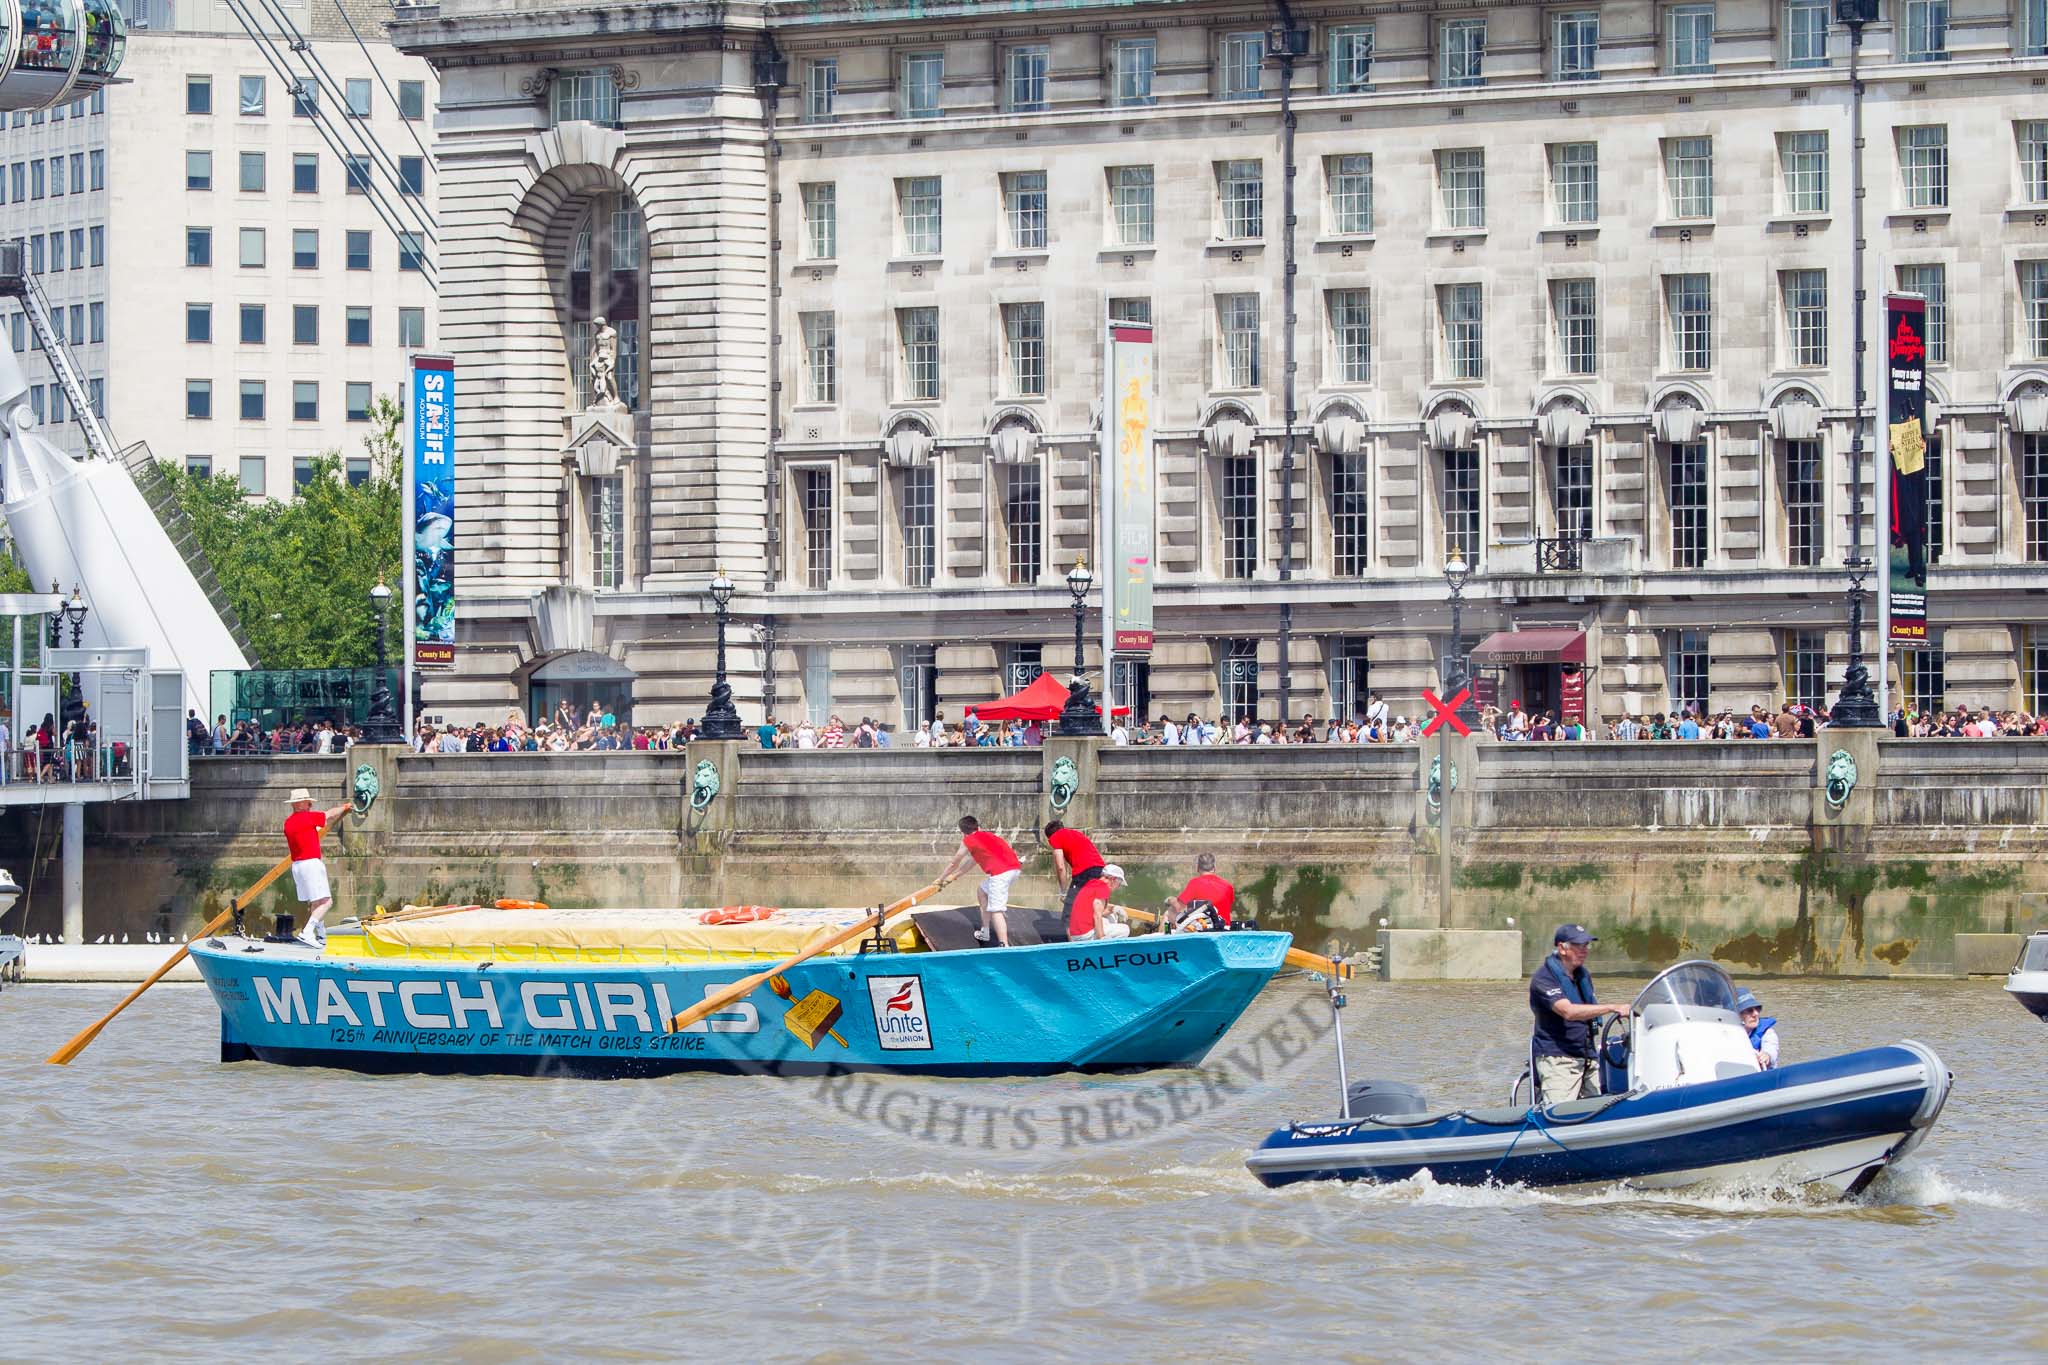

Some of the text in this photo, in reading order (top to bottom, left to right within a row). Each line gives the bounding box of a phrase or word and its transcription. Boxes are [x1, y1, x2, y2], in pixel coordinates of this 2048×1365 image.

[1892, 626, 1924, 636] County Hall
[1119, 634, 1149, 645] County Hall
[418, 650, 451, 660] County Hall
[1488, 650, 1544, 663] County Hall
[1067, 950, 1180, 972] BALFOUR
[252, 976, 504, 1029] MATCH
[520, 981, 760, 1033] GIRLS
[880, 1014, 923, 1033] unite
[330, 1028, 705, 1051] 125th ANNIVERSARY OF THE MATCH GIRLS STRIKE
[900, 1035, 924, 1043] UNION
